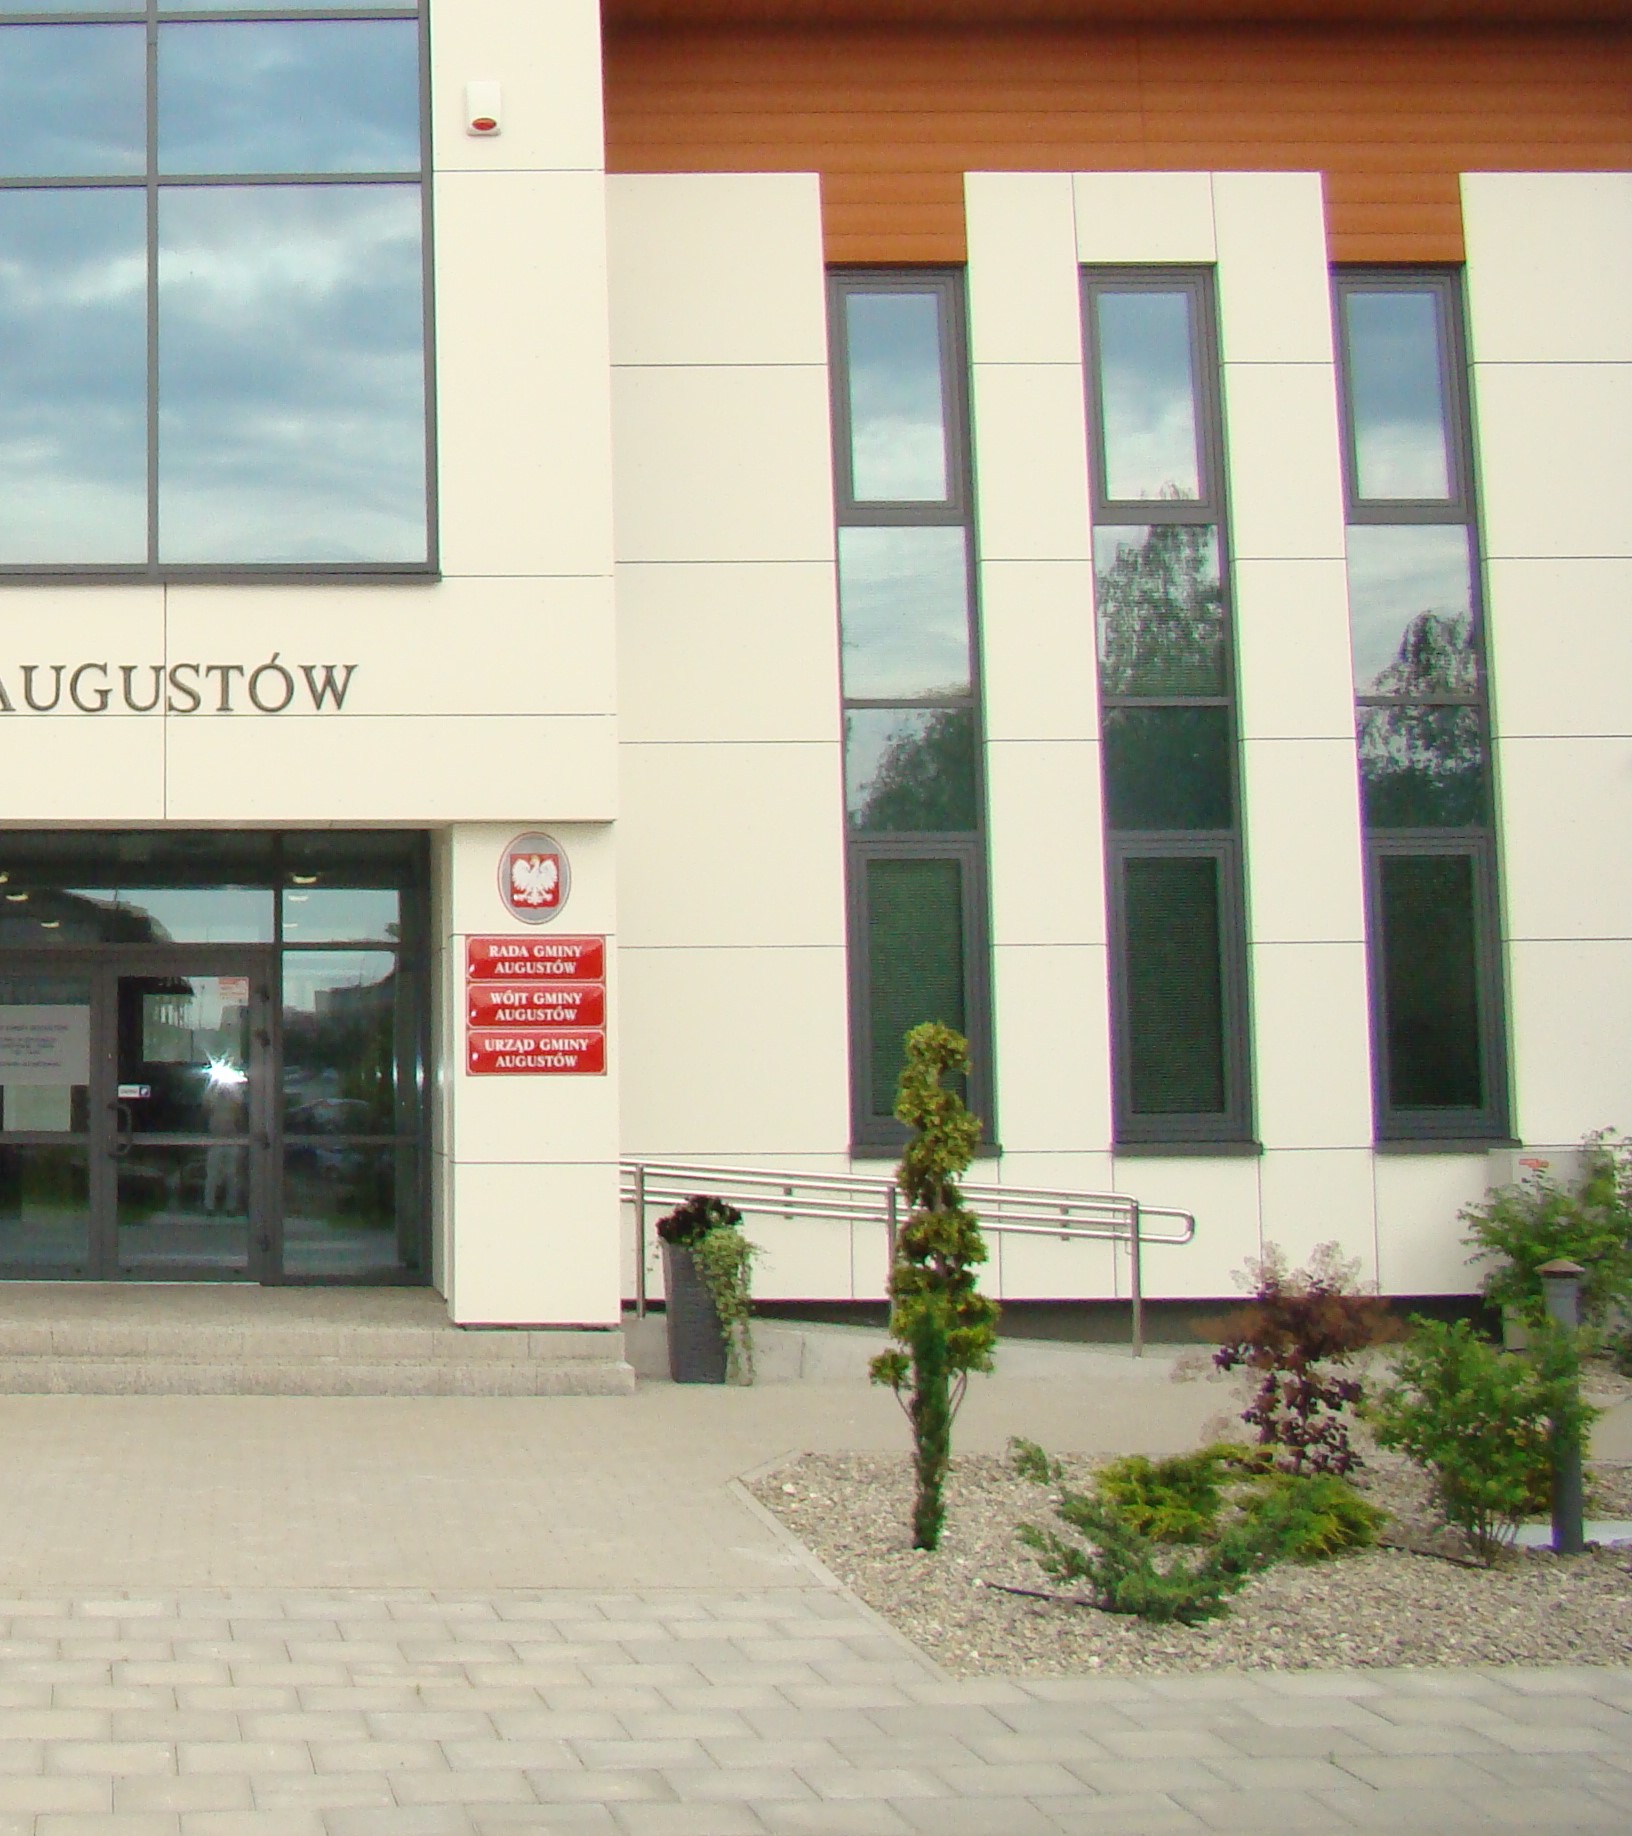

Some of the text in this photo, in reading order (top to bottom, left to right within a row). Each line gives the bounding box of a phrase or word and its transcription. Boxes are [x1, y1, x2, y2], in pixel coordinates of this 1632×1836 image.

[489, 945, 583, 958] RADA GMINY
[494, 959, 577, 974] AUGUSTÓW
[490, 990, 582, 1006] WÓJT GMINY
[495, 1006, 577, 1021] AUGUSTÓW
[485, 1039, 589, 1054] URZĄD GMINY
[496, 1053, 578, 1067] AUGUSTÓW
